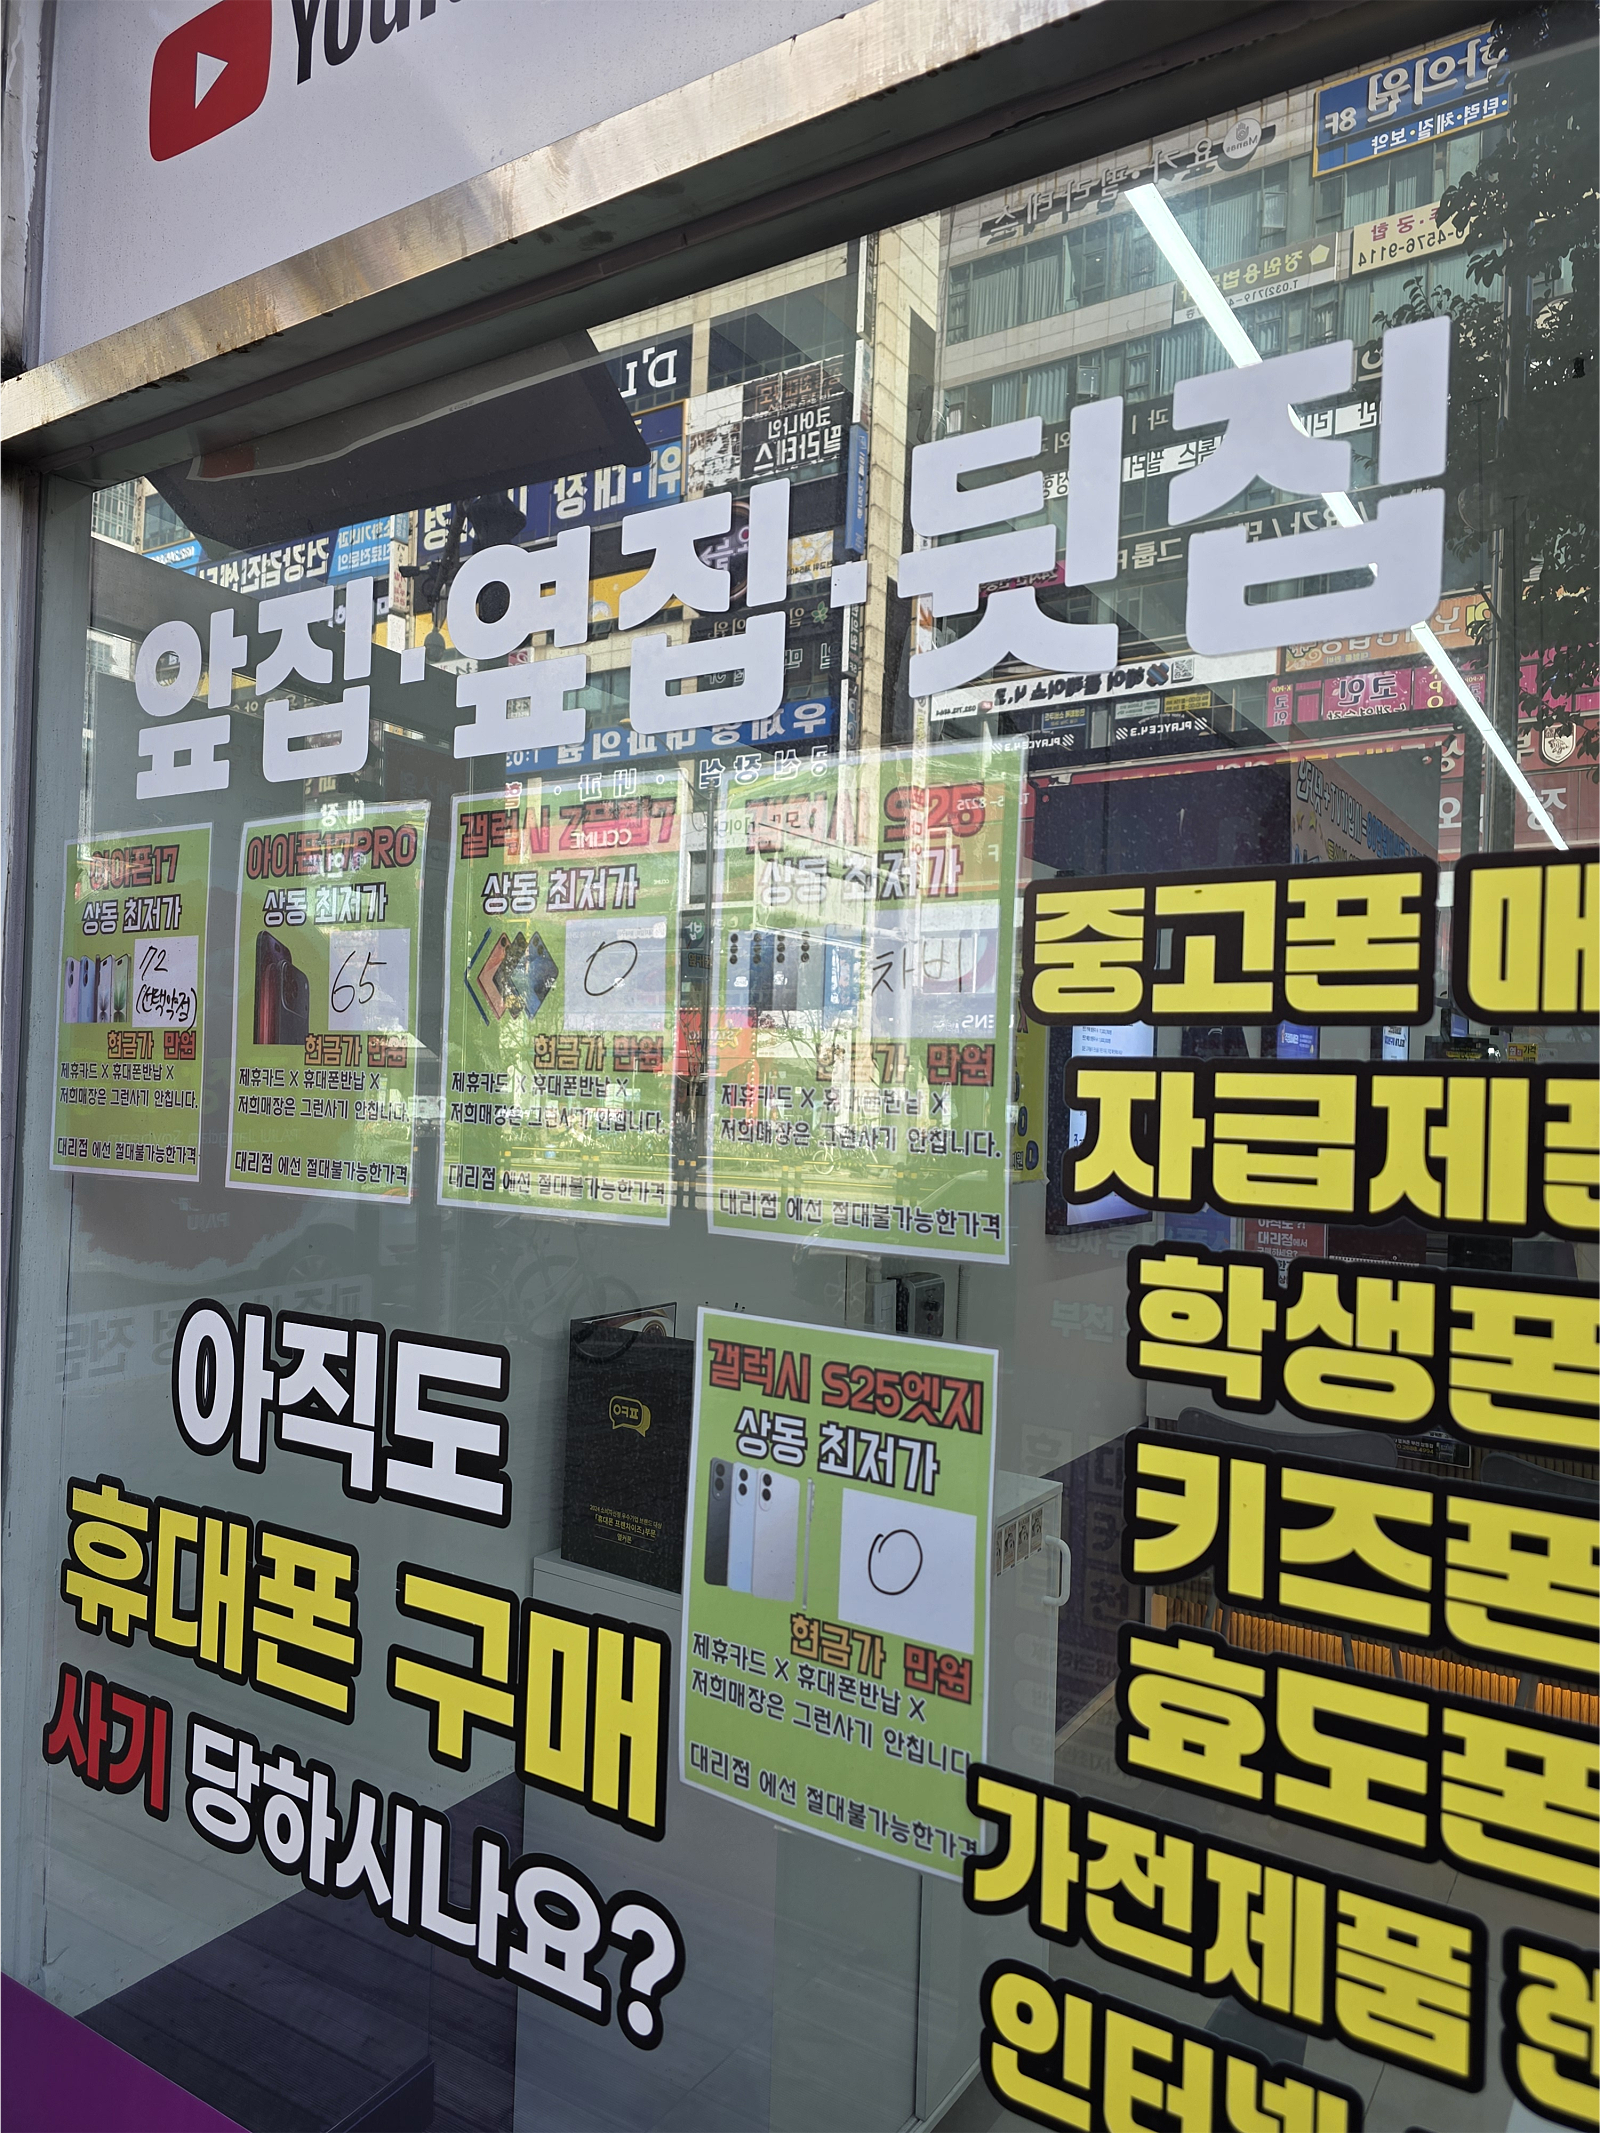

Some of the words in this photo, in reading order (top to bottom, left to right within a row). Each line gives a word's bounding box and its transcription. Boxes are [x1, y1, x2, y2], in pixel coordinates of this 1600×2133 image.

[897, 316, 1452, 698] 뒷집
[460, 807, 550, 859] 갤럭시
[883, 782, 985, 843] S25
[482, 871, 539, 914] 상동
[547, 863, 639, 913] 최저가
[759, 858, 828, 905] 상동
[842, 845, 964, 900] 최저가
[83, 901, 118, 935] 상동
[122, 895, 182, 933] 최저가
[264, 888, 306, 927] 상동
[314, 882, 387, 926] 최저가
[1030, 870, 1424, 1016] 중고폰
[331, 951, 386, 1013] 65
[60, 1061, 98, 1081] 제휴카드
[112, 1062, 163, 1081] 휴대폰반납
[107, 1031, 154, 1059] 현금가
[164, 1030, 196, 1060] 만원
[304, 1034, 362, 1066] 현금가
[367, 1034, 407, 1067] 만원
[534, 1034, 605, 1071] 현금가
[612, 1034, 664, 1072] 만원
[926, 1044, 995, 1086] 만원
[60, 1087, 107, 1107] 저희매장은
[110, 1089, 149, 1108] 그런사기
[154, 1091, 198, 1109] 안칩니다.
[239, 1067, 284, 1088] 제휴카드
[303, 1068, 365, 1091] 휴대폰반납
[451, 1072, 509, 1094] 제휴카드
[532, 1074, 612, 1098] 휴대폰반납
[721, 1084, 793, 1110] 제휴카드
[238, 1094, 295, 1117] 저희매장은
[300, 1096, 349, 1120] 그런사기
[450, 1103, 522, 1126] 저희매장은
[57, 1136, 88, 1158] 대리점
[92, 1141, 111, 1160] 에선
[115, 1141, 197, 1165] 절대불가능한가격
[720, 1119, 810, 1148] 저희매장은
[235, 1152, 273, 1175] 대리점
[278, 1156, 301, 1177] 에선
[306, 1157, 407, 1185] 절대불가능한가격
[448, 1164, 496, 1191] 대리점
[502, 1168, 530, 1194] 에선
[538, 1171, 665, 1205] 절대불가능한가격
[720, 1188, 778, 1219] 대리점
[785, 1194, 823, 1223] 에선
[833, 1196, 1001, 1240] 절대불가능한가격
[1258, 1231, 1308, 1248] 대리점에서
[1137, 1252, 1600, 1454] 학생폰
[176, 1306, 507, 1517] 아직도
[709, 1338, 810, 1403] 갤럭시
[821, 1360, 983, 1434] S25엣지
[734, 1406, 807, 1467] 상동
[817, 1421, 940, 1496] 최저가
[1131, 1441, 1600, 1676] 키즈폰
[64, 1481, 359, 1716] 휴대폰
[392, 1570, 666, 1830] 구매
[692, 1632, 769, 1678] 제휴카드
[797, 1663, 902, 1718] 휴대폰반납
[790, 1612, 886, 1680] 현금가
[904, 1645, 973, 1705] 만원
[692, 1667, 786, 1720] 저희매장은
[794, 1699, 874, 1750] 그런사기
[1126, 1634, 1600, 1900] 효도폰
[689, 1739, 750, 1788] 대리점
[758, 1771, 797, 1806] 에선
[806, 1785, 979, 1858] 절대불가능한가격
[48, 1672, 168, 1812] 사기
[191, 1722, 676, 2040] 당하시나요?
[973, 1775, 1473, 2079] 가전제품
